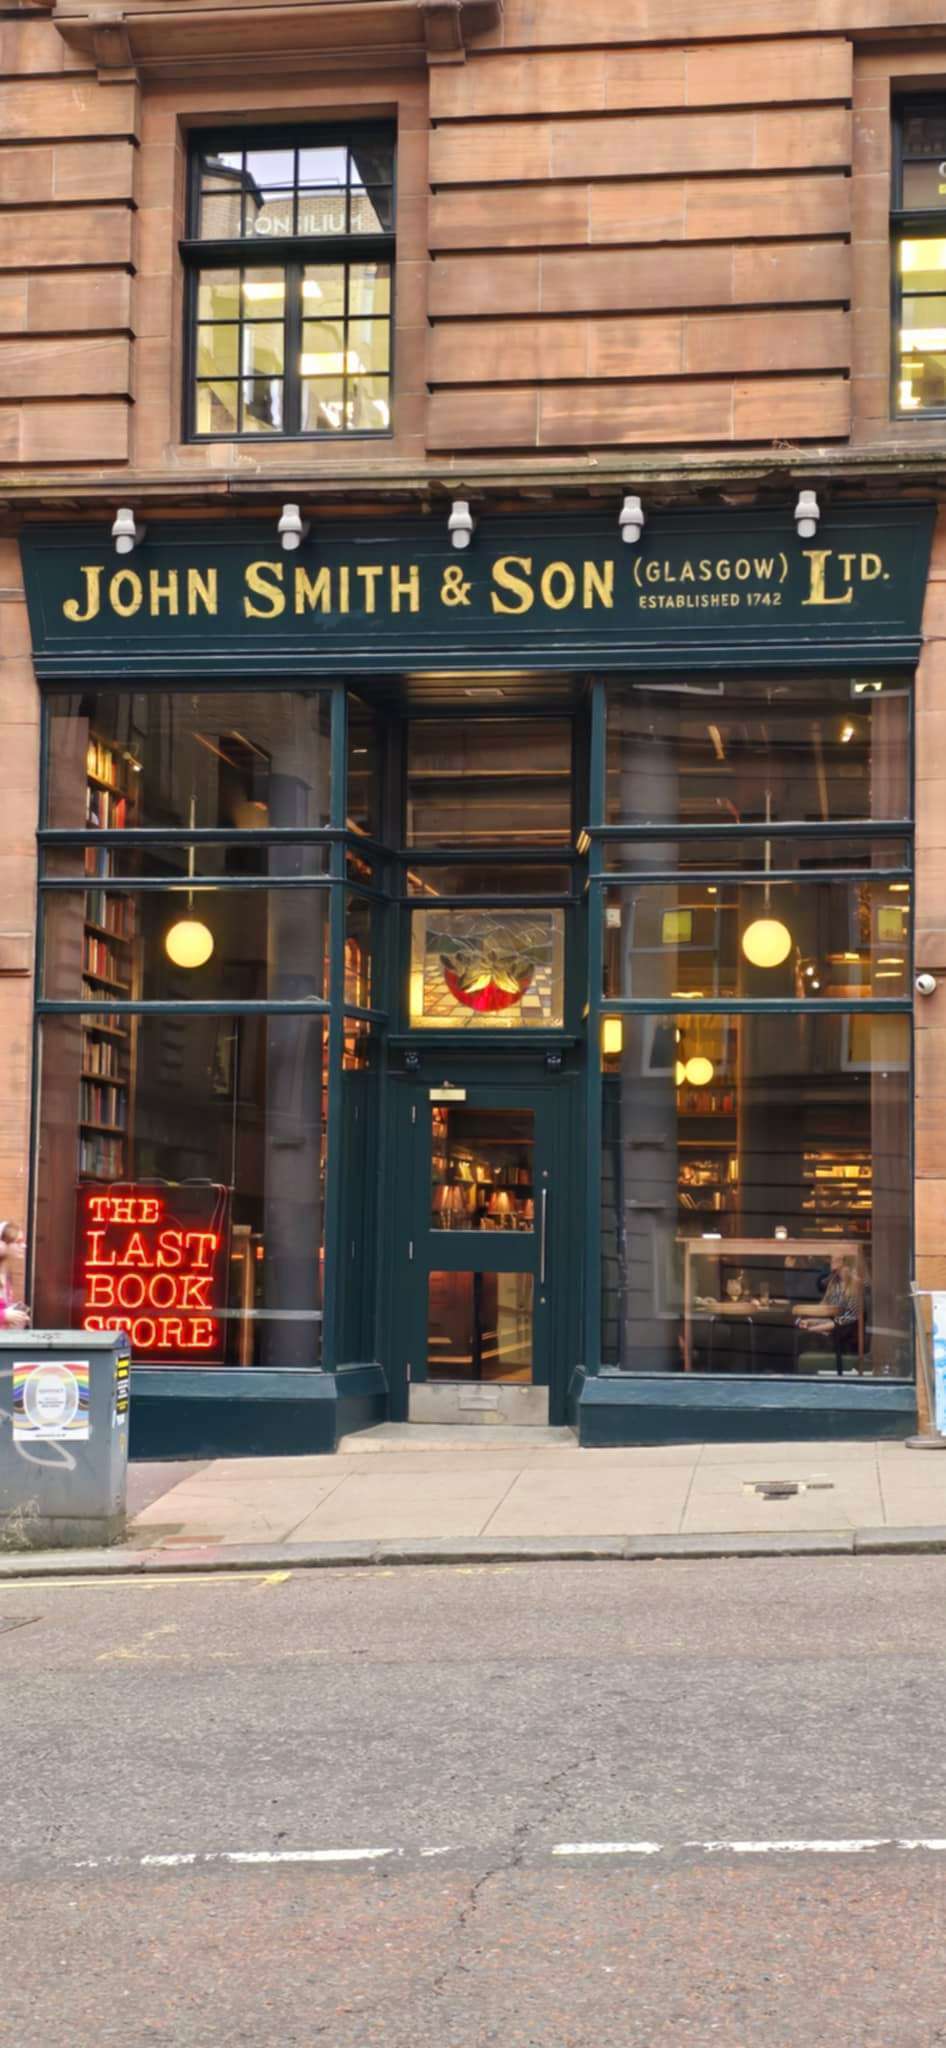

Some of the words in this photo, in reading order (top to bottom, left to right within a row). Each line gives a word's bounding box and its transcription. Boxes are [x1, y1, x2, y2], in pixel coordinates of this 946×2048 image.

[62, 565, 218, 622] JOHN
[244, 560, 420, 619] SMITH
[440, 565, 472, 607] &
[490, 555, 615, 615] SON
[632, 552, 789, 588] (GLASGOW)
[802, 549, 890, 606] LTD.
[638, 593, 740, 609] ESTABLISHED
[746, 592, 782, 606] 1742
[89, 1196, 160, 1224] THE
[84, 1230, 217, 1268] LAST
[85, 1273, 214, 1310] BOOK
